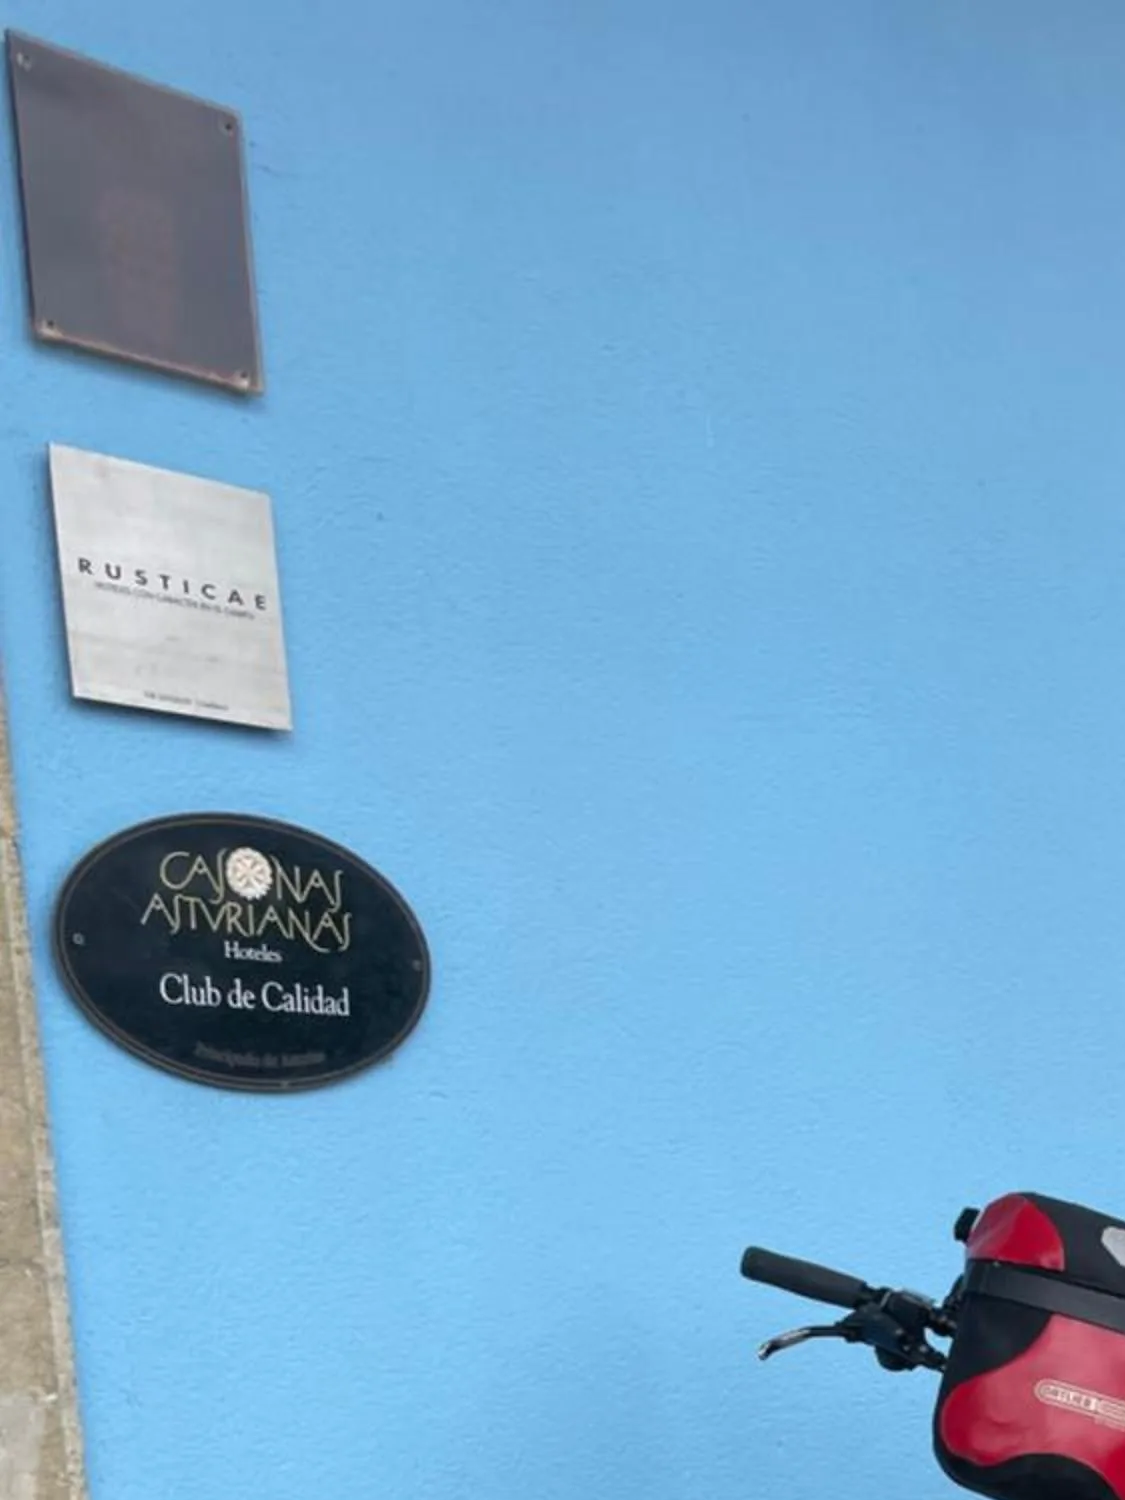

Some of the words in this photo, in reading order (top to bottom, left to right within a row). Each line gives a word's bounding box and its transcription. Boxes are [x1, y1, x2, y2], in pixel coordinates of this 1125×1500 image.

[77, 557, 267, 611] RUSTICAE
[223, 940, 283, 963] Hoteles
[158, 972, 222, 1008] Club
[226, 977, 257, 1010] de
[261, 981, 351, 1017] Calidad
